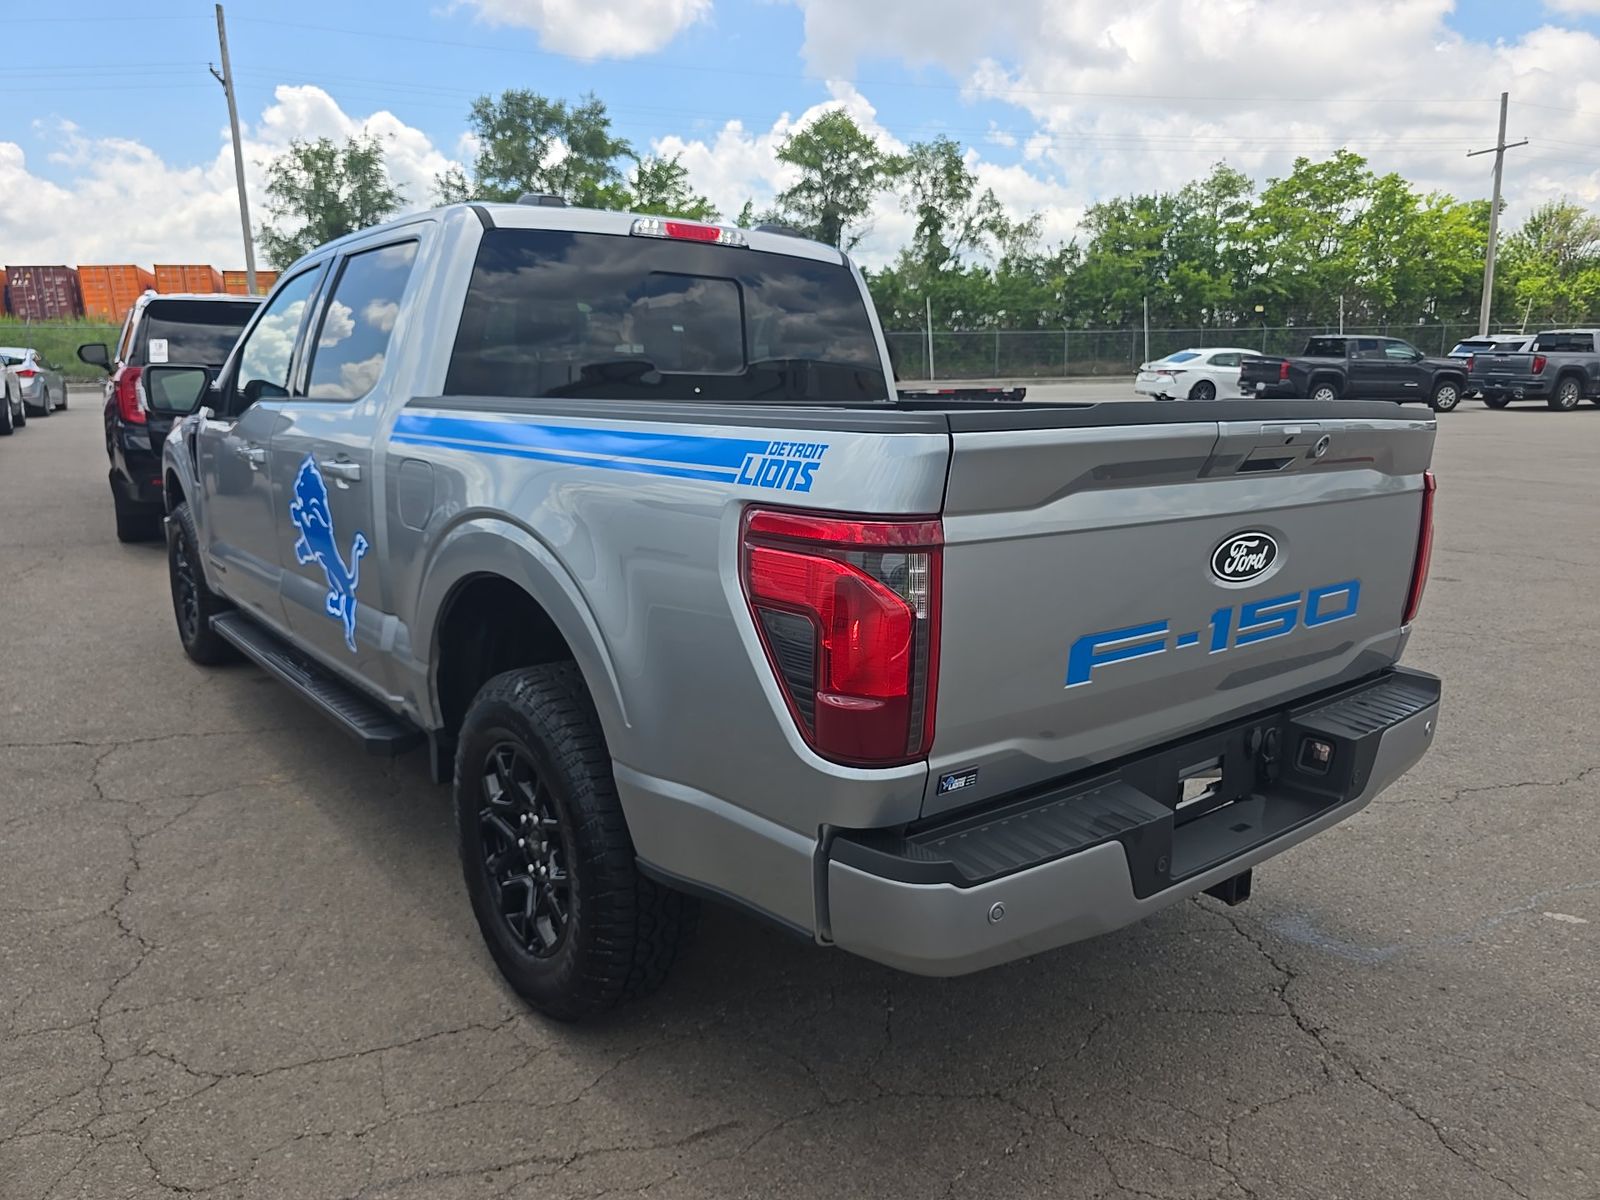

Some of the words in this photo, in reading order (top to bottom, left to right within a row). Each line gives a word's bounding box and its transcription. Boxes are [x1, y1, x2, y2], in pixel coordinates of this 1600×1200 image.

[767, 441, 829, 460] DETROIT
[736, 456, 821, 493] LIONS
[1223, 539, 1269, 574] Ford
[1064, 578, 1361, 689] F-150
